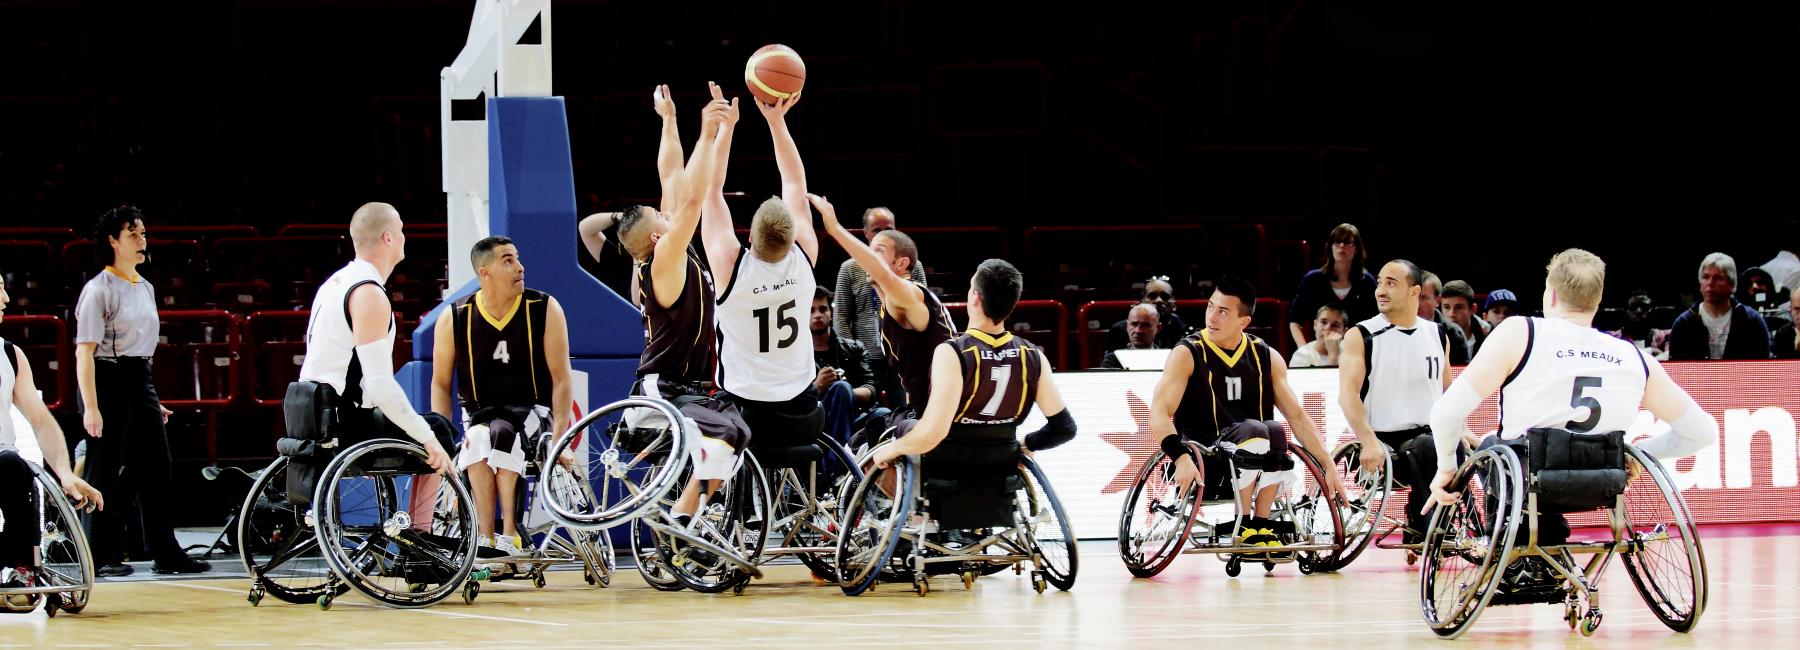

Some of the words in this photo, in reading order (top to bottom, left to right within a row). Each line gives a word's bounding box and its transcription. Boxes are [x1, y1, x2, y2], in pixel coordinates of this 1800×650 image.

[752, 285, 768, 294] C.S
[752, 299, 799, 353] 15
[492, 340, 510, 364] 4
[1556, 349, 1575, 358] C.S
[1580, 351, 1623, 366] MEAUX
[1425, 356, 1439, 380] 11
[1224, 376, 1242, 401] 11
[1564, 376, 1603, 433] 5
